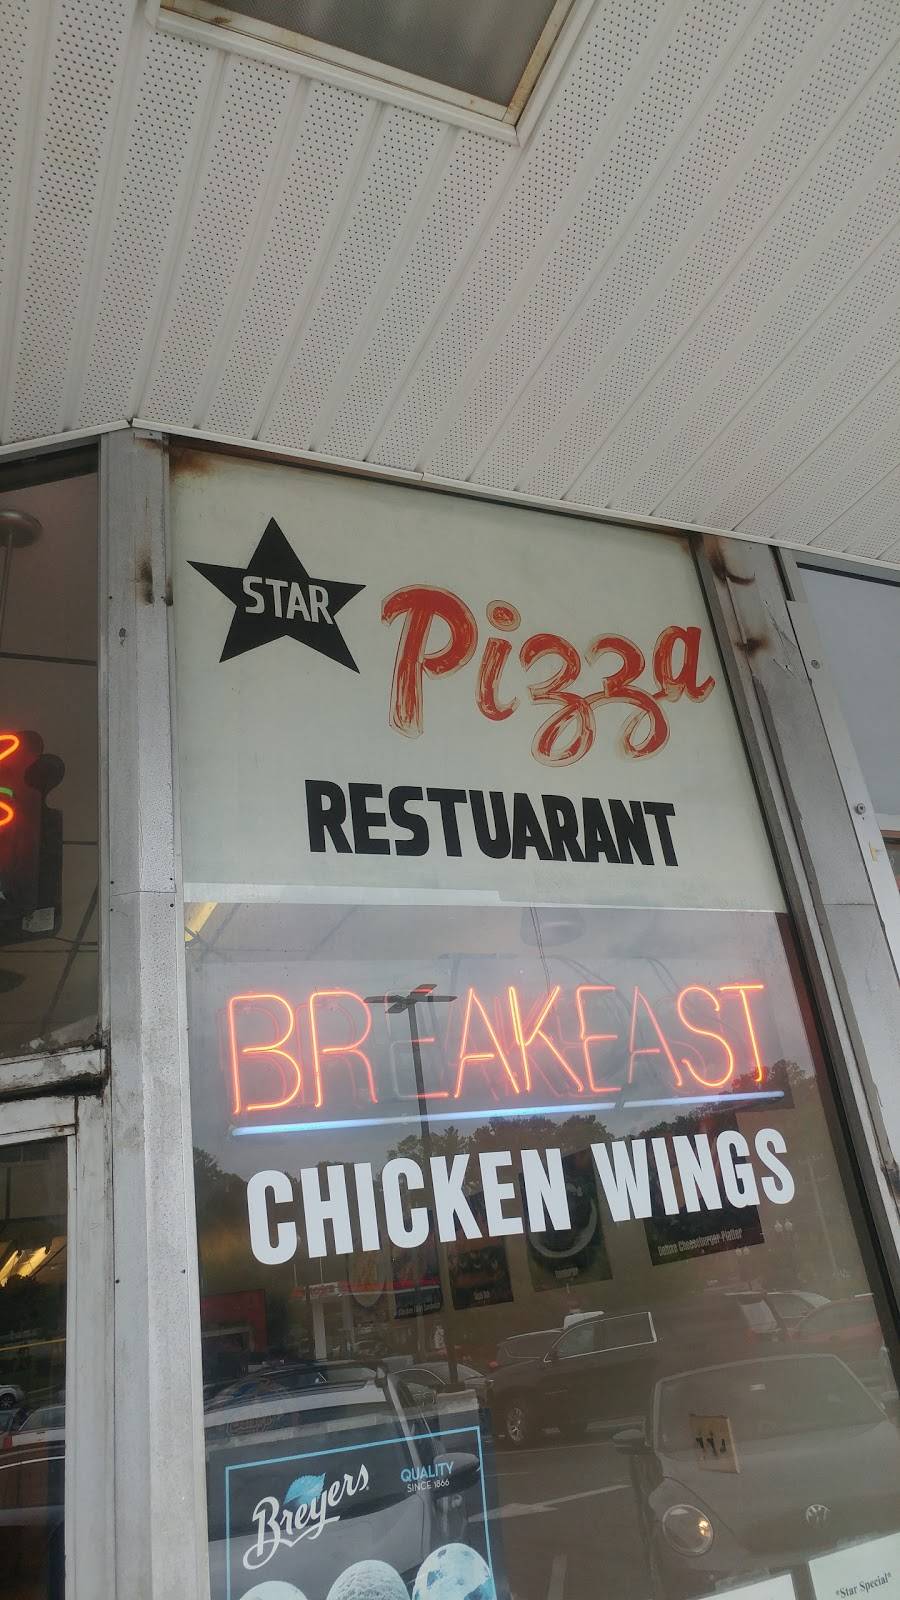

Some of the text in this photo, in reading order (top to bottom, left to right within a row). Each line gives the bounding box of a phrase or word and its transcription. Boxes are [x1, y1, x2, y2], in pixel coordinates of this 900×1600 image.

[241, 574, 333, 625] STAR
[381, 583, 716, 767] Pizza
[304, 780, 679, 867] RESTUARANT
[246, 1127, 796, 1265] CHICKEN WINGS
[400, 1461, 455, 1483] QUALITY
[407, 1478, 451, 1493] SINCE 1866
[242, 1463, 370, 1570] Breyers
